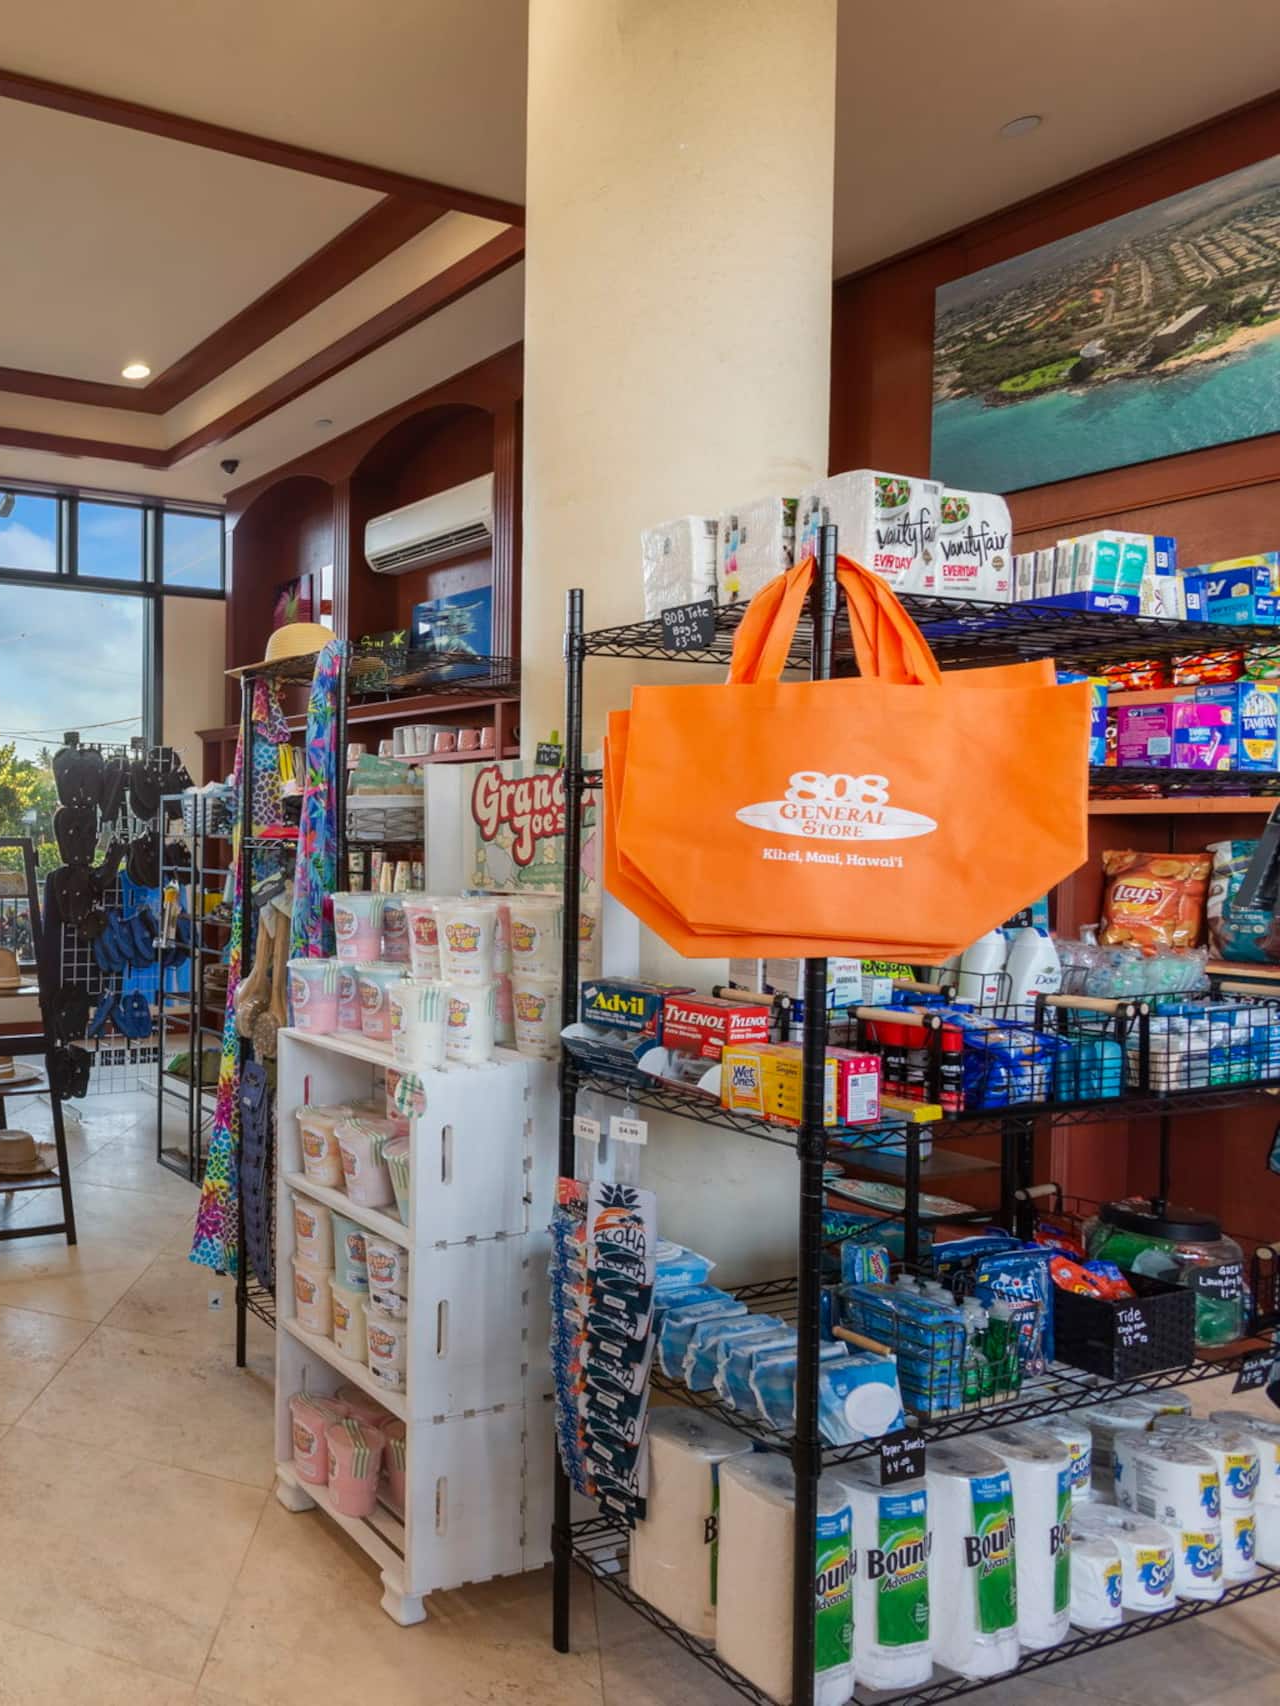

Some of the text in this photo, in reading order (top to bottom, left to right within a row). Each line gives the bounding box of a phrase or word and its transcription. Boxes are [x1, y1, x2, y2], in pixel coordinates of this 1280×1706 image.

[943, 565, 978, 577] EVERYDAY
[663, 609, 685, 626] 808
[1242, 716, 1277, 731] TAMPAX
[784, 771, 890, 804] 808
[473, 768, 594, 838] Grand
[779, 803, 887, 826] GENERAL
[802, 820, 865, 837] STORE
[762, 848, 803, 864] Kihei,
[806, 851, 843, 866] Maui,
[592, 992, 645, 1016] Advil
[665, 1004, 726, 1029] TYLENOL
[730, 1014, 767, 1028] TYLENOL
[733, 1065, 755, 1077] Wet
[732, 1074, 755, 1088] Ones
[1116, 1307, 1141, 1323] Tide
[964, 1515, 1016, 1568] Boun
[867, 1531, 933, 1580] Bouny
[816, 1549, 857, 1597] ouny
